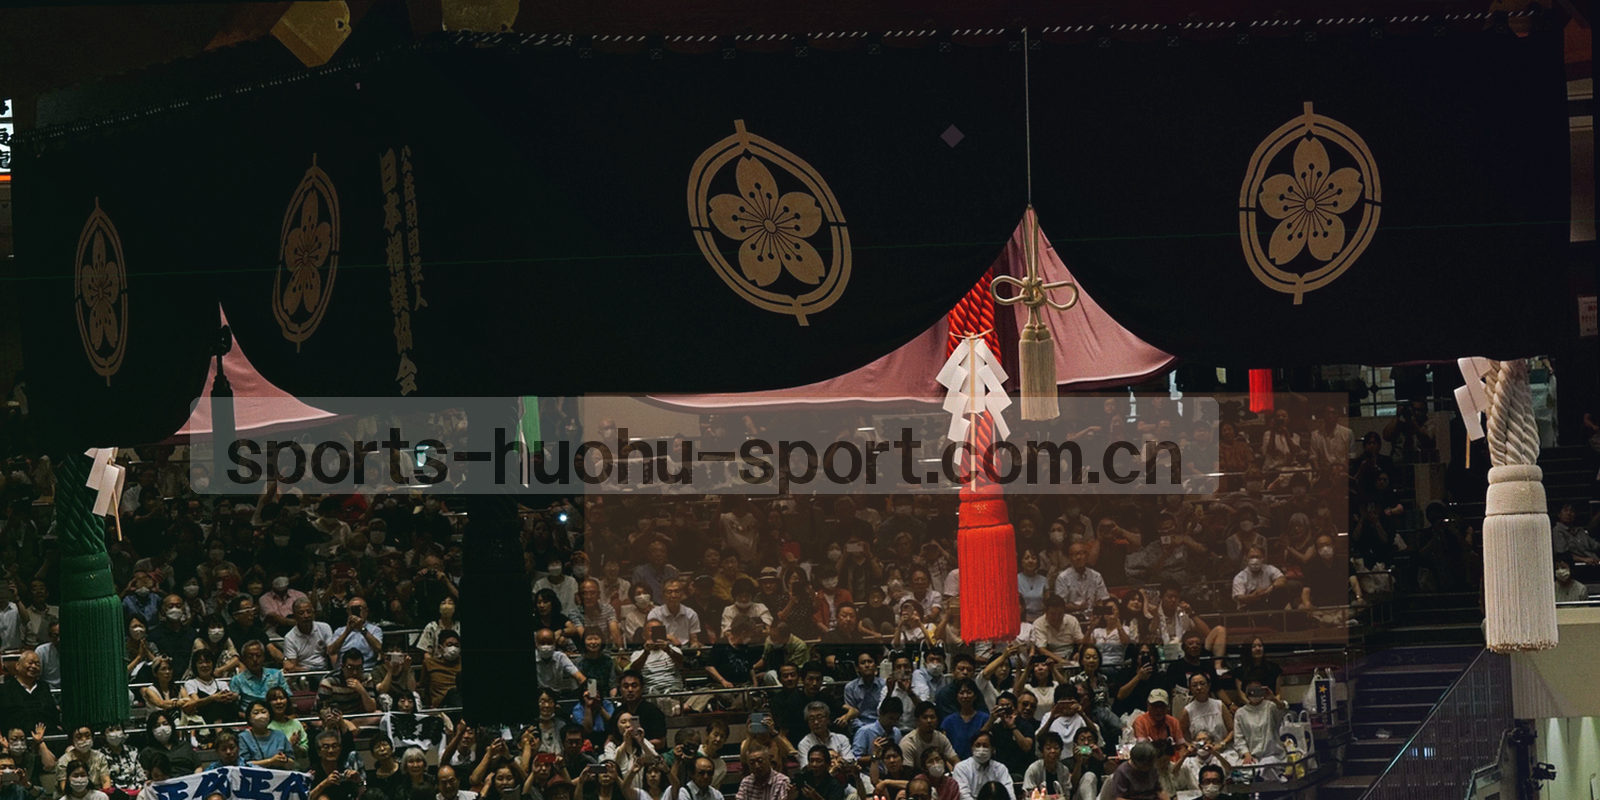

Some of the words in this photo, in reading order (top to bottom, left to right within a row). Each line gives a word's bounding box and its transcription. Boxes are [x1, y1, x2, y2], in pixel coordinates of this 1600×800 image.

[381, 148, 418, 396] 日本相撲協会
